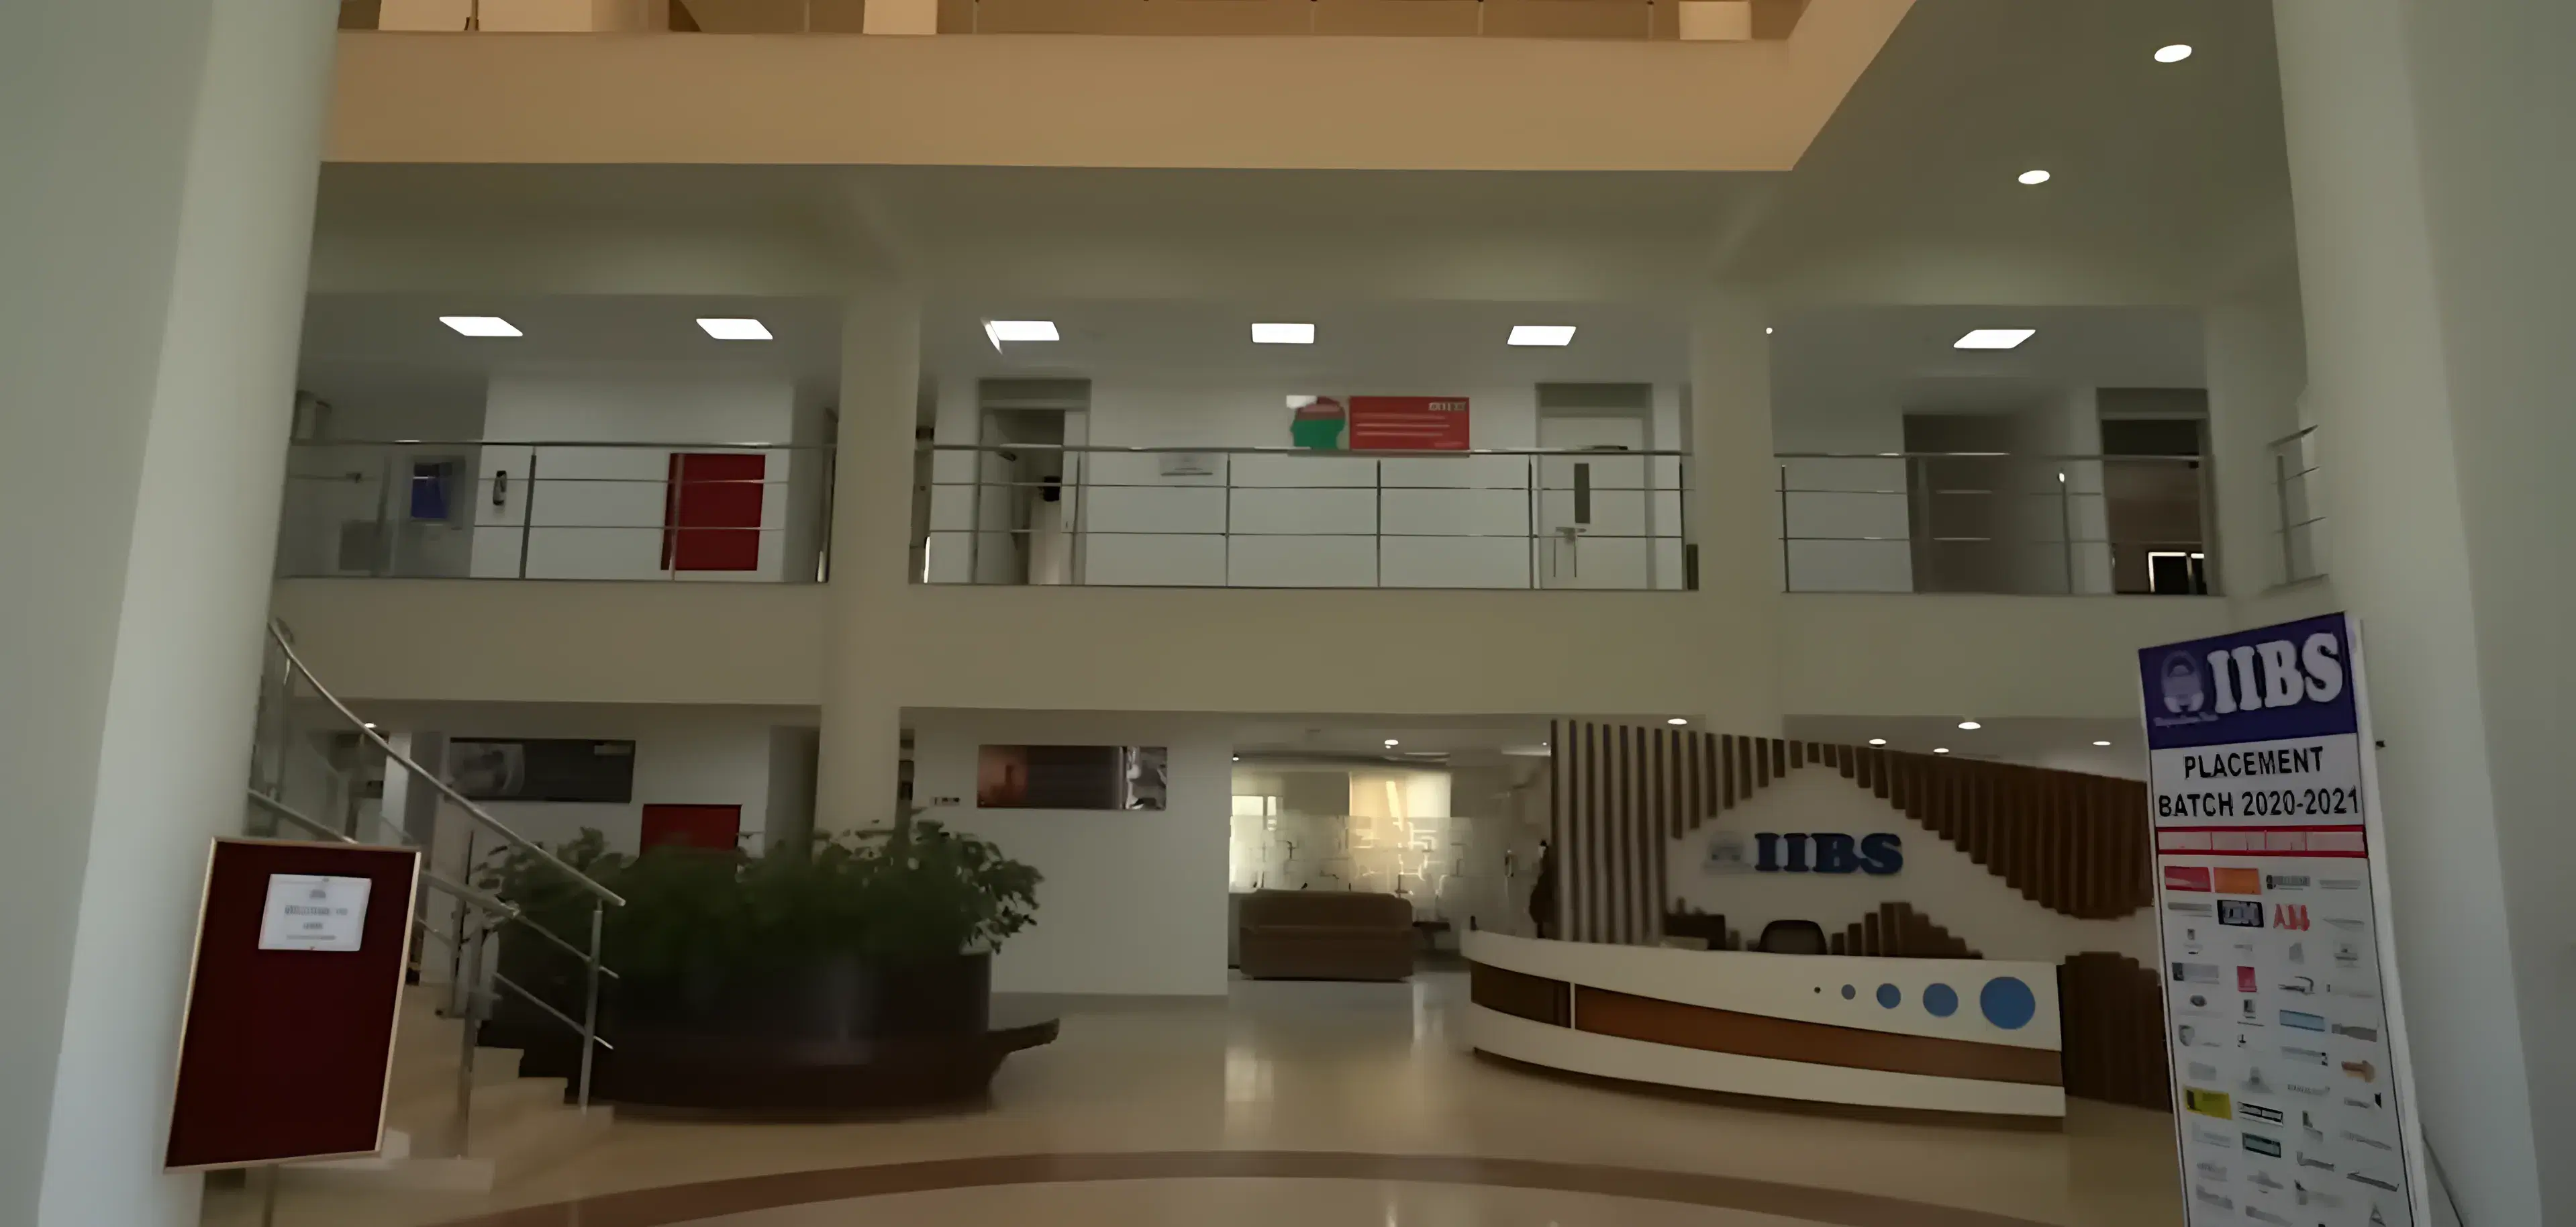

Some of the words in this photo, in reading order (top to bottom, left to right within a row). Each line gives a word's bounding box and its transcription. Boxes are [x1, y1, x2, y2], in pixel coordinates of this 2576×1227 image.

[2207, 632, 2343, 714] IIBS
[2184, 746, 2324, 779] PLACEMENT
[2159, 791, 2234, 818] BATCH
[2242, 786, 2359, 816] 2020-2021
[1754, 832, 1904, 875] IIBS
